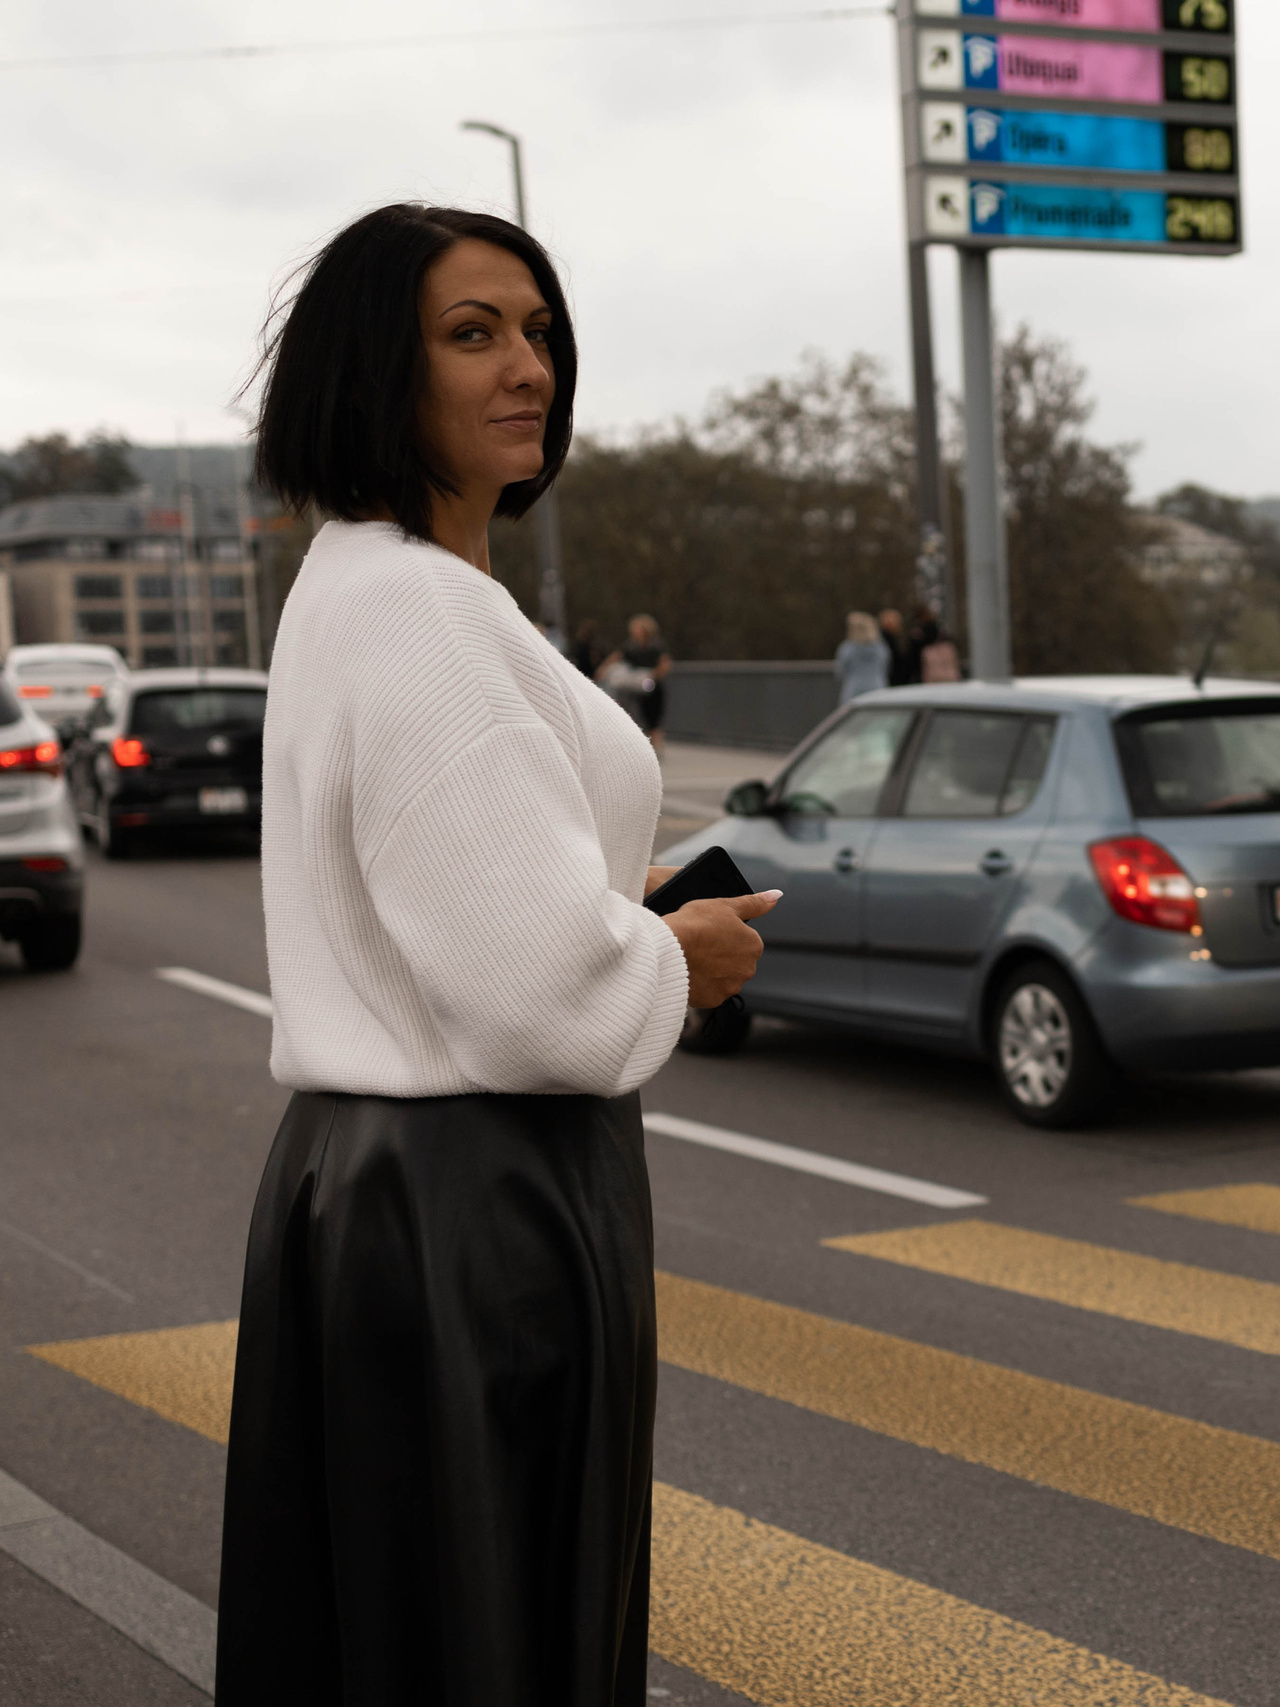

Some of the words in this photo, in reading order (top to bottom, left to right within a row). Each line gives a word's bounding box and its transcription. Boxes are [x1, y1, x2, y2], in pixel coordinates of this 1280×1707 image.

[1007, 53, 1079, 83] Utoquai
[1181, 57, 1229, 98] 50
[1011, 195, 1132, 228] Promenade
